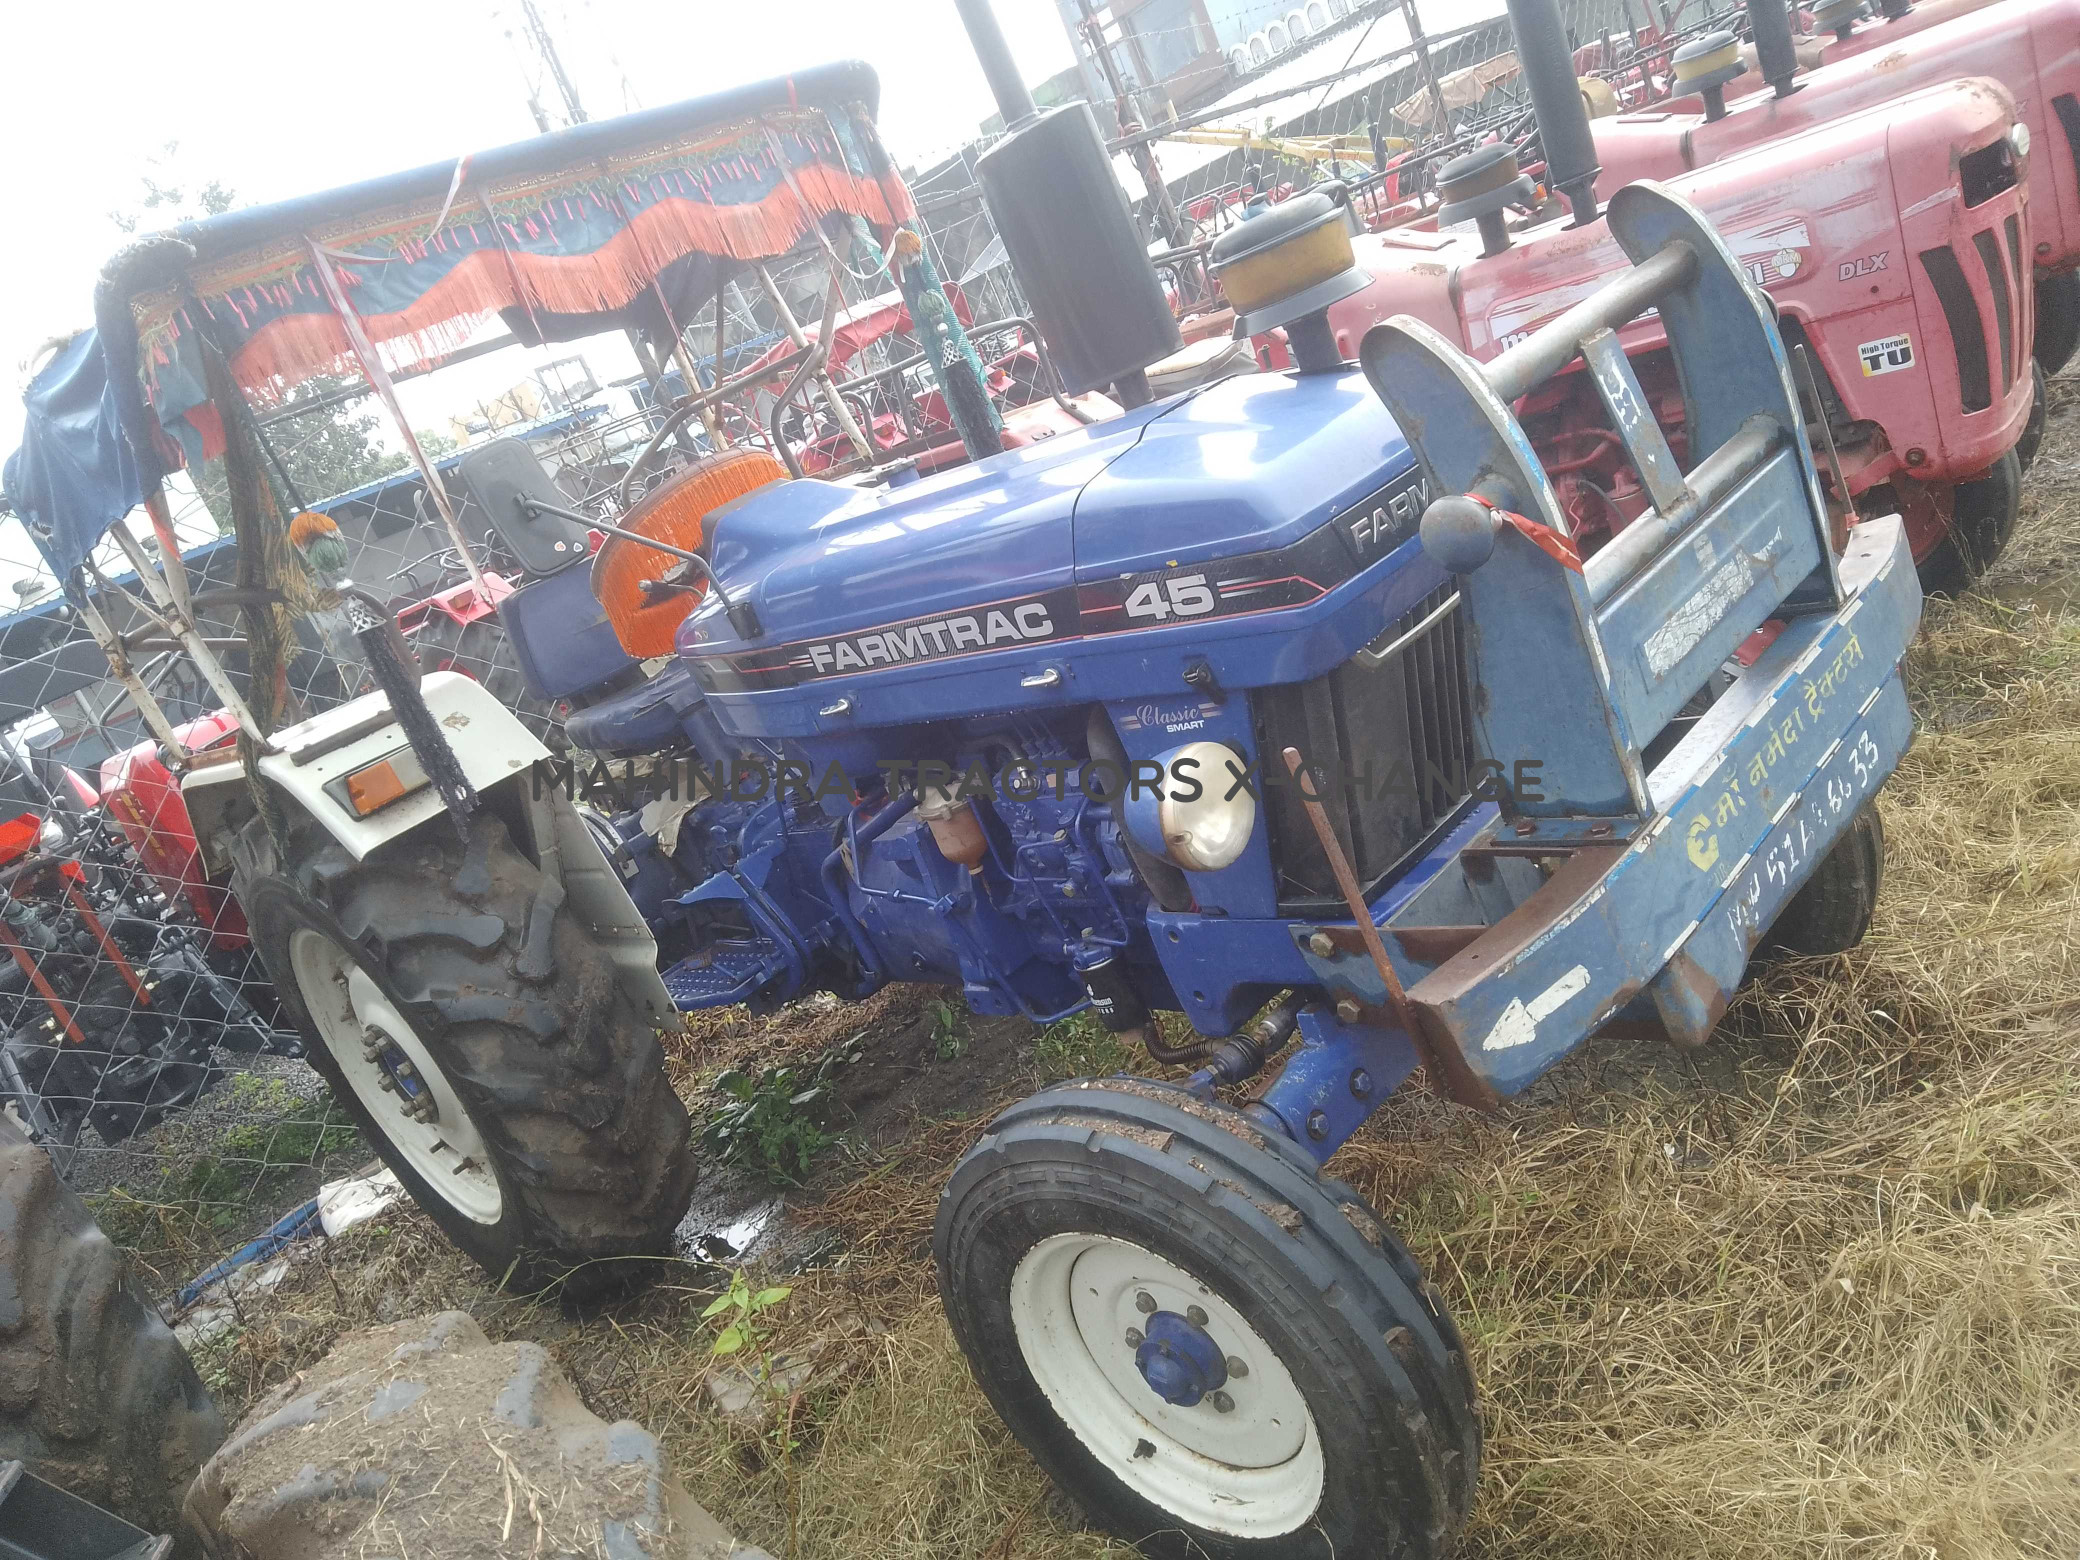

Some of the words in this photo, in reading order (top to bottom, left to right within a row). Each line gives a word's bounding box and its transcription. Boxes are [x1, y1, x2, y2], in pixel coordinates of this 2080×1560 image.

[1839, 251, 1889, 281] DLX
[1861, 344, 1879, 355] High
[1880, 337, 1909, 350] Torque
[1863, 346, 1912, 371] TU
[808, 603, 1054, 673] FARMTRAC
[1125, 574, 1215, 620] 45
[1136, 704, 1199, 726] Classic
[1166, 720, 1205, 733] SMART
[1747, 707, 1805, 786] नर्मदा
